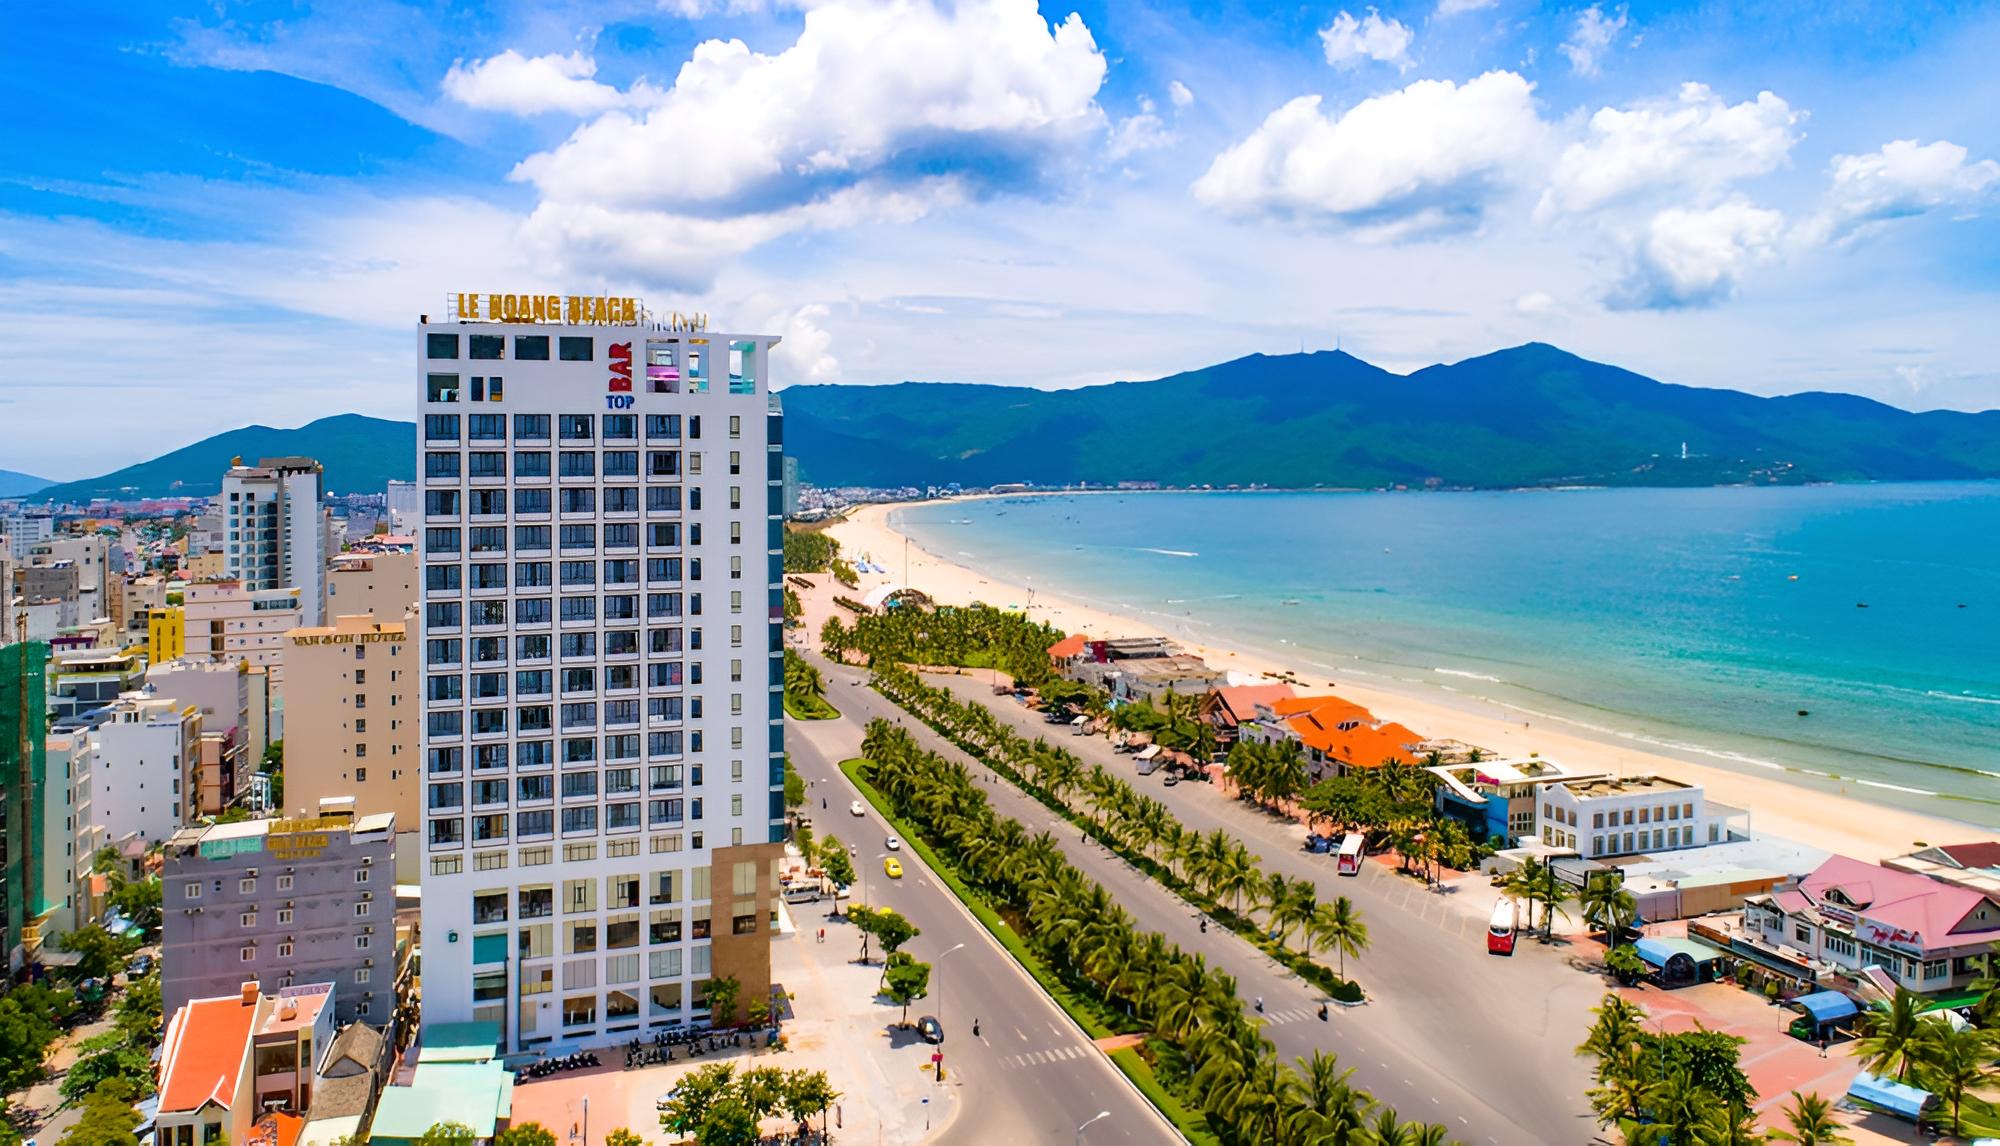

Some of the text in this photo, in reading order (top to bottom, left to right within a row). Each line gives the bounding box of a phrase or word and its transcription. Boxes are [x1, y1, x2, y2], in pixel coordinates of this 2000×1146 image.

[458, 294, 479, 318] LE
[608, 342, 632, 392] BAR
[606, 395, 635, 409] TOP
